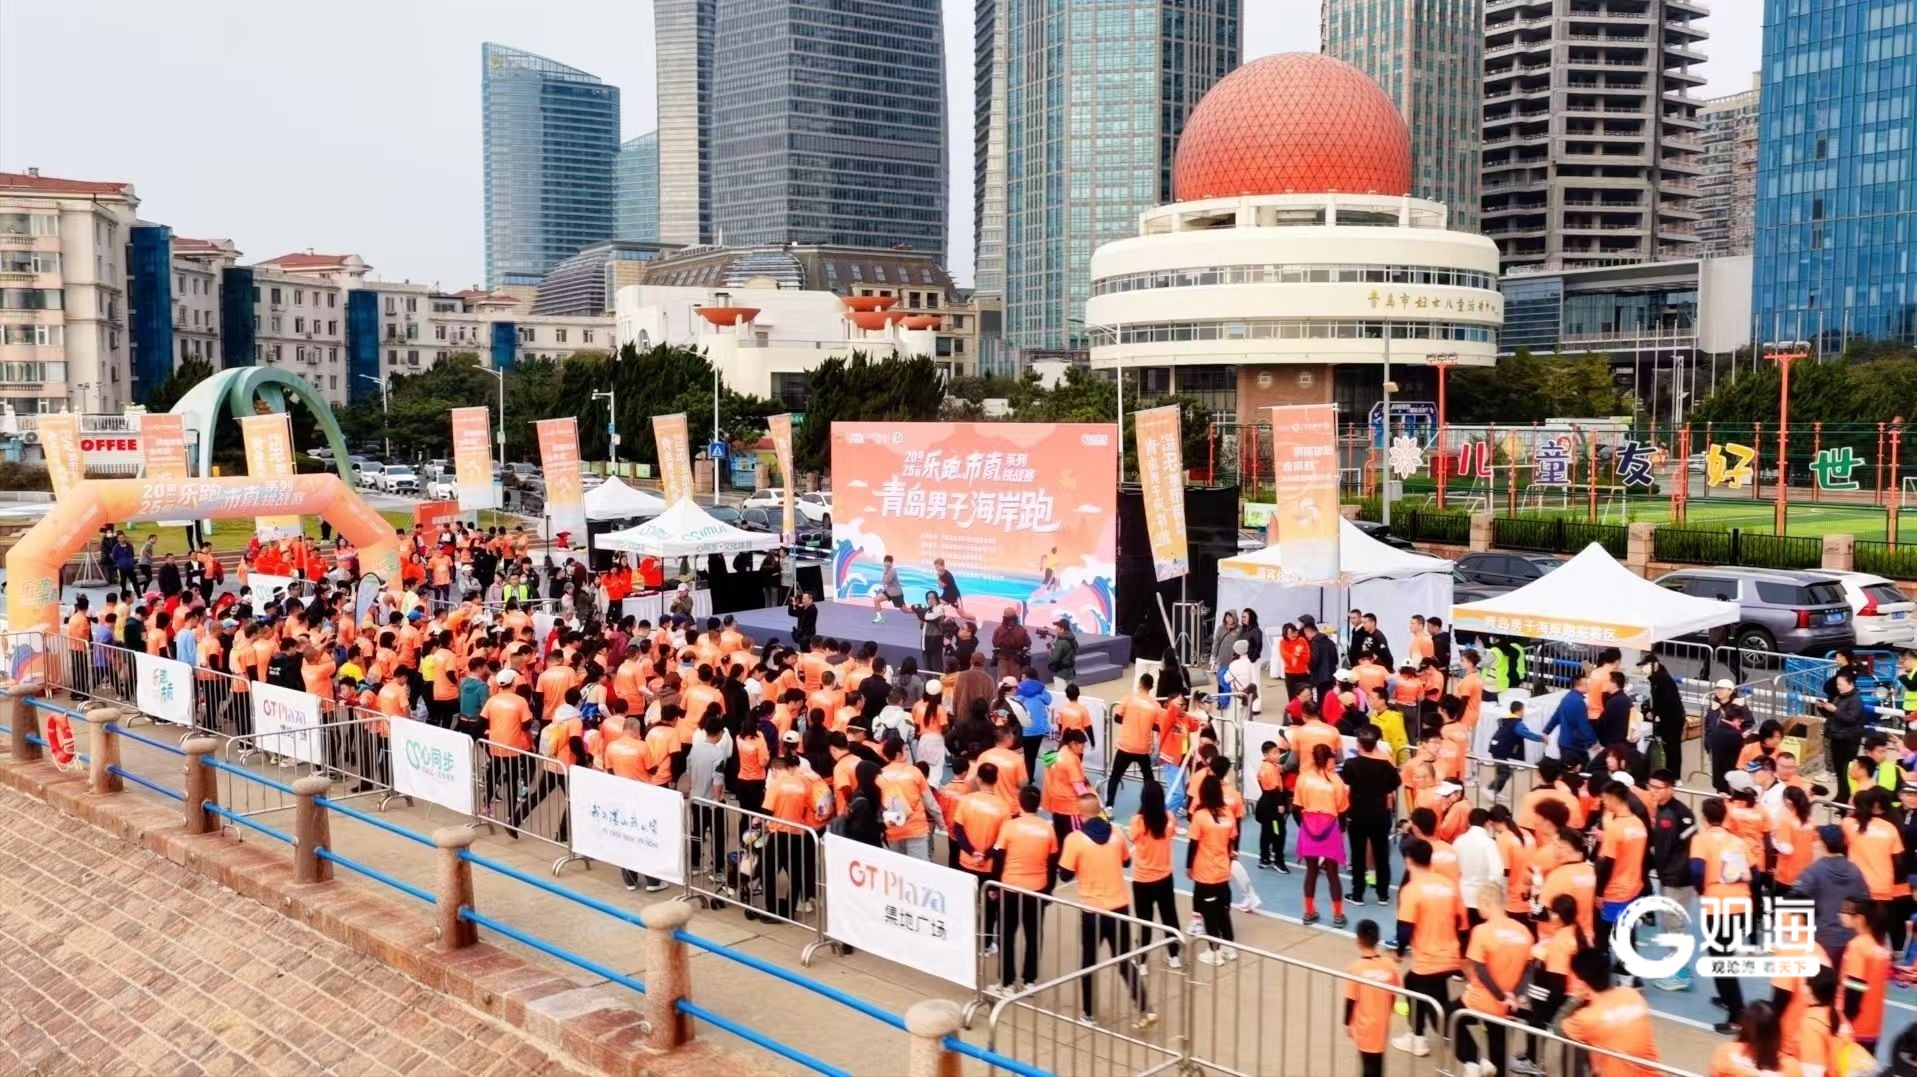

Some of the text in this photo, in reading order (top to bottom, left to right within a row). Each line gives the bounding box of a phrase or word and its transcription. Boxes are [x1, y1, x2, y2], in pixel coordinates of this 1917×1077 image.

[1006, 454, 1028, 467] 系列
[1003, 468, 1035, 482] 挑战赛
[143, 483, 165, 499] 20
[873, 476, 1062, 533] 青岛男子海岸跑
[420, 745, 455, 772] 心同步
[848, 859, 947, 914] GT Plaza
[884, 903, 948, 941] 集地广场
